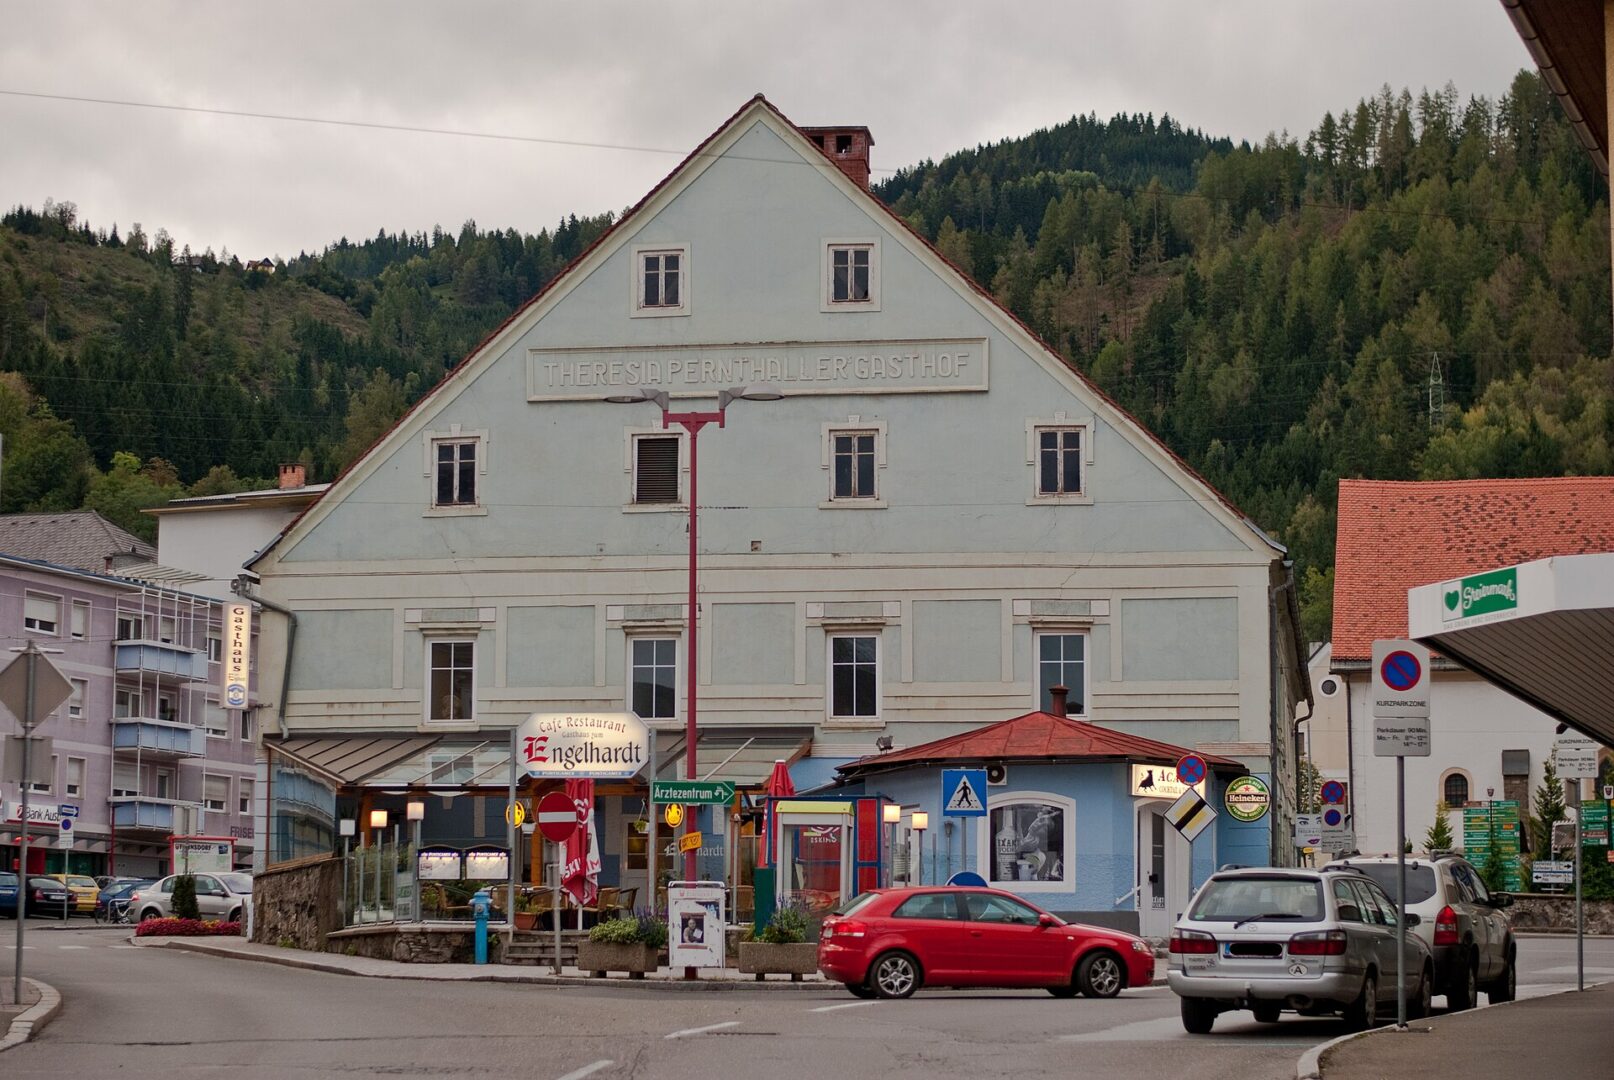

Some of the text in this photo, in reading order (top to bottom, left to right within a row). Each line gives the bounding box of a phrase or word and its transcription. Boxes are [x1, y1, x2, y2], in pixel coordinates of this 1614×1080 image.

[544, 360, 663, 387] THERESIA
[855, 352, 970, 380] GASTHOF
[232, 607, 245, 672] Gasthaus
[565, 716, 627, 733] Restaurant
[562, 731, 604, 740] Gasthaus zum
[523, 735, 643, 770] Engelhardt
[654, 785, 713, 799] Ärztezentrum
[1229, 794, 1266, 802] Heineken
[25, 806, 43, 820] Bank
[1293, 965, 1303, 975] A
